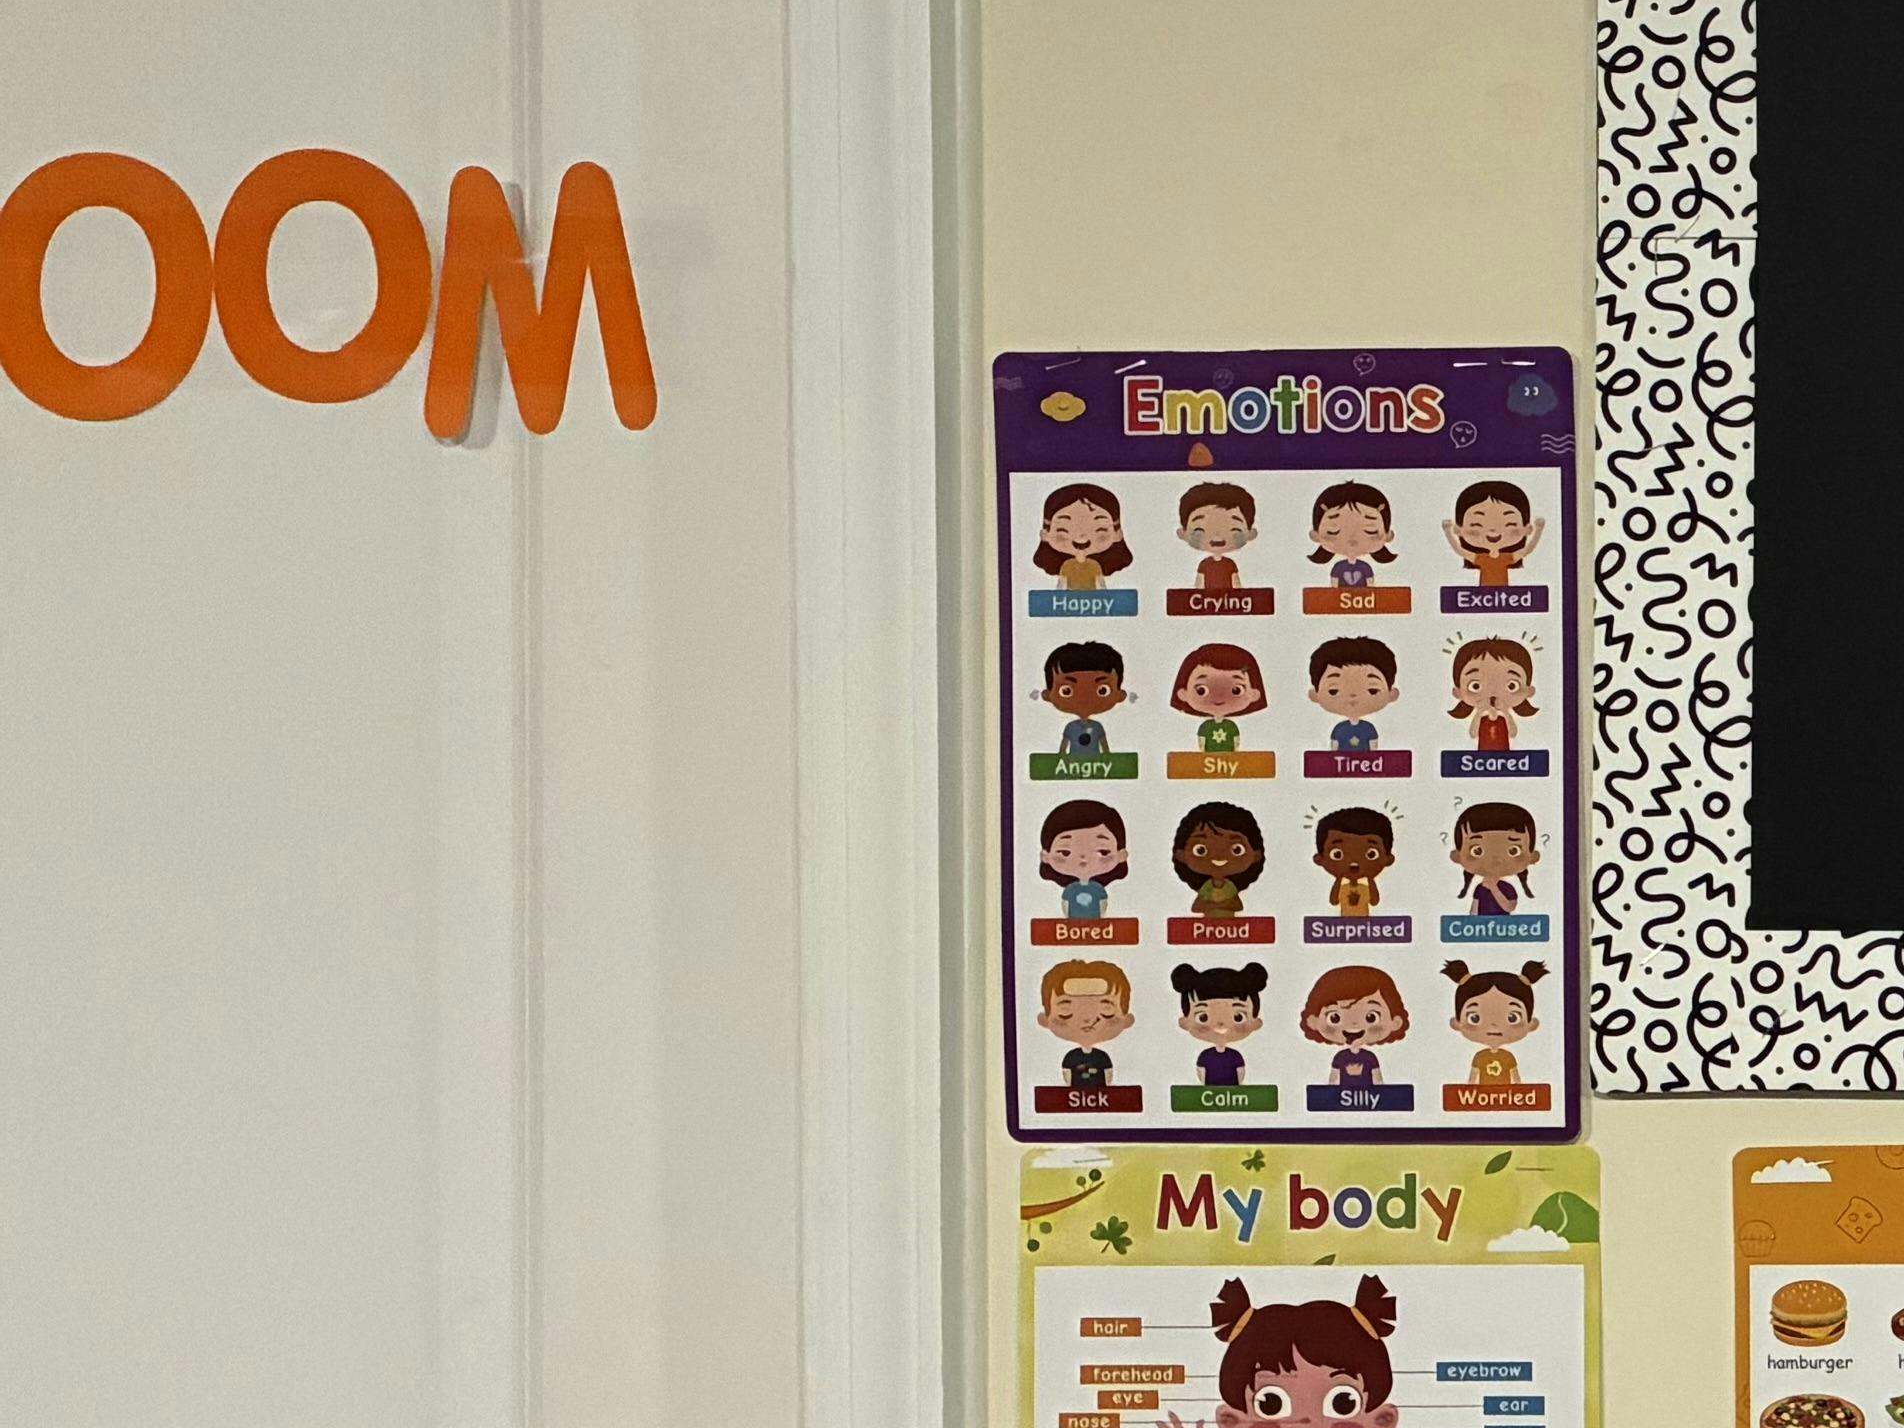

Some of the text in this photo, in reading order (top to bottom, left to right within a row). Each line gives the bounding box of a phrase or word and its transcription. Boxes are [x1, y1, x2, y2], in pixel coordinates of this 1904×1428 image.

[1123, 375, 1445, 436] Emotions
[1051, 595, 1114, 613] Happy
[1189, 593, 1253, 613] Crying
[1339, 593, 1376, 609] Sad
[1457, 591, 1532, 608] Excited
[1311, 920, 1405, 941] Surprised
[1448, 919, 1542, 937] Confused
[1457, 1088, 1537, 1106] Worried
[1157, 1172, 1462, 1242] My body
[1093, 1319, 1128, 1334] hair
[1767, 1354, 1853, 1373] hamburger
